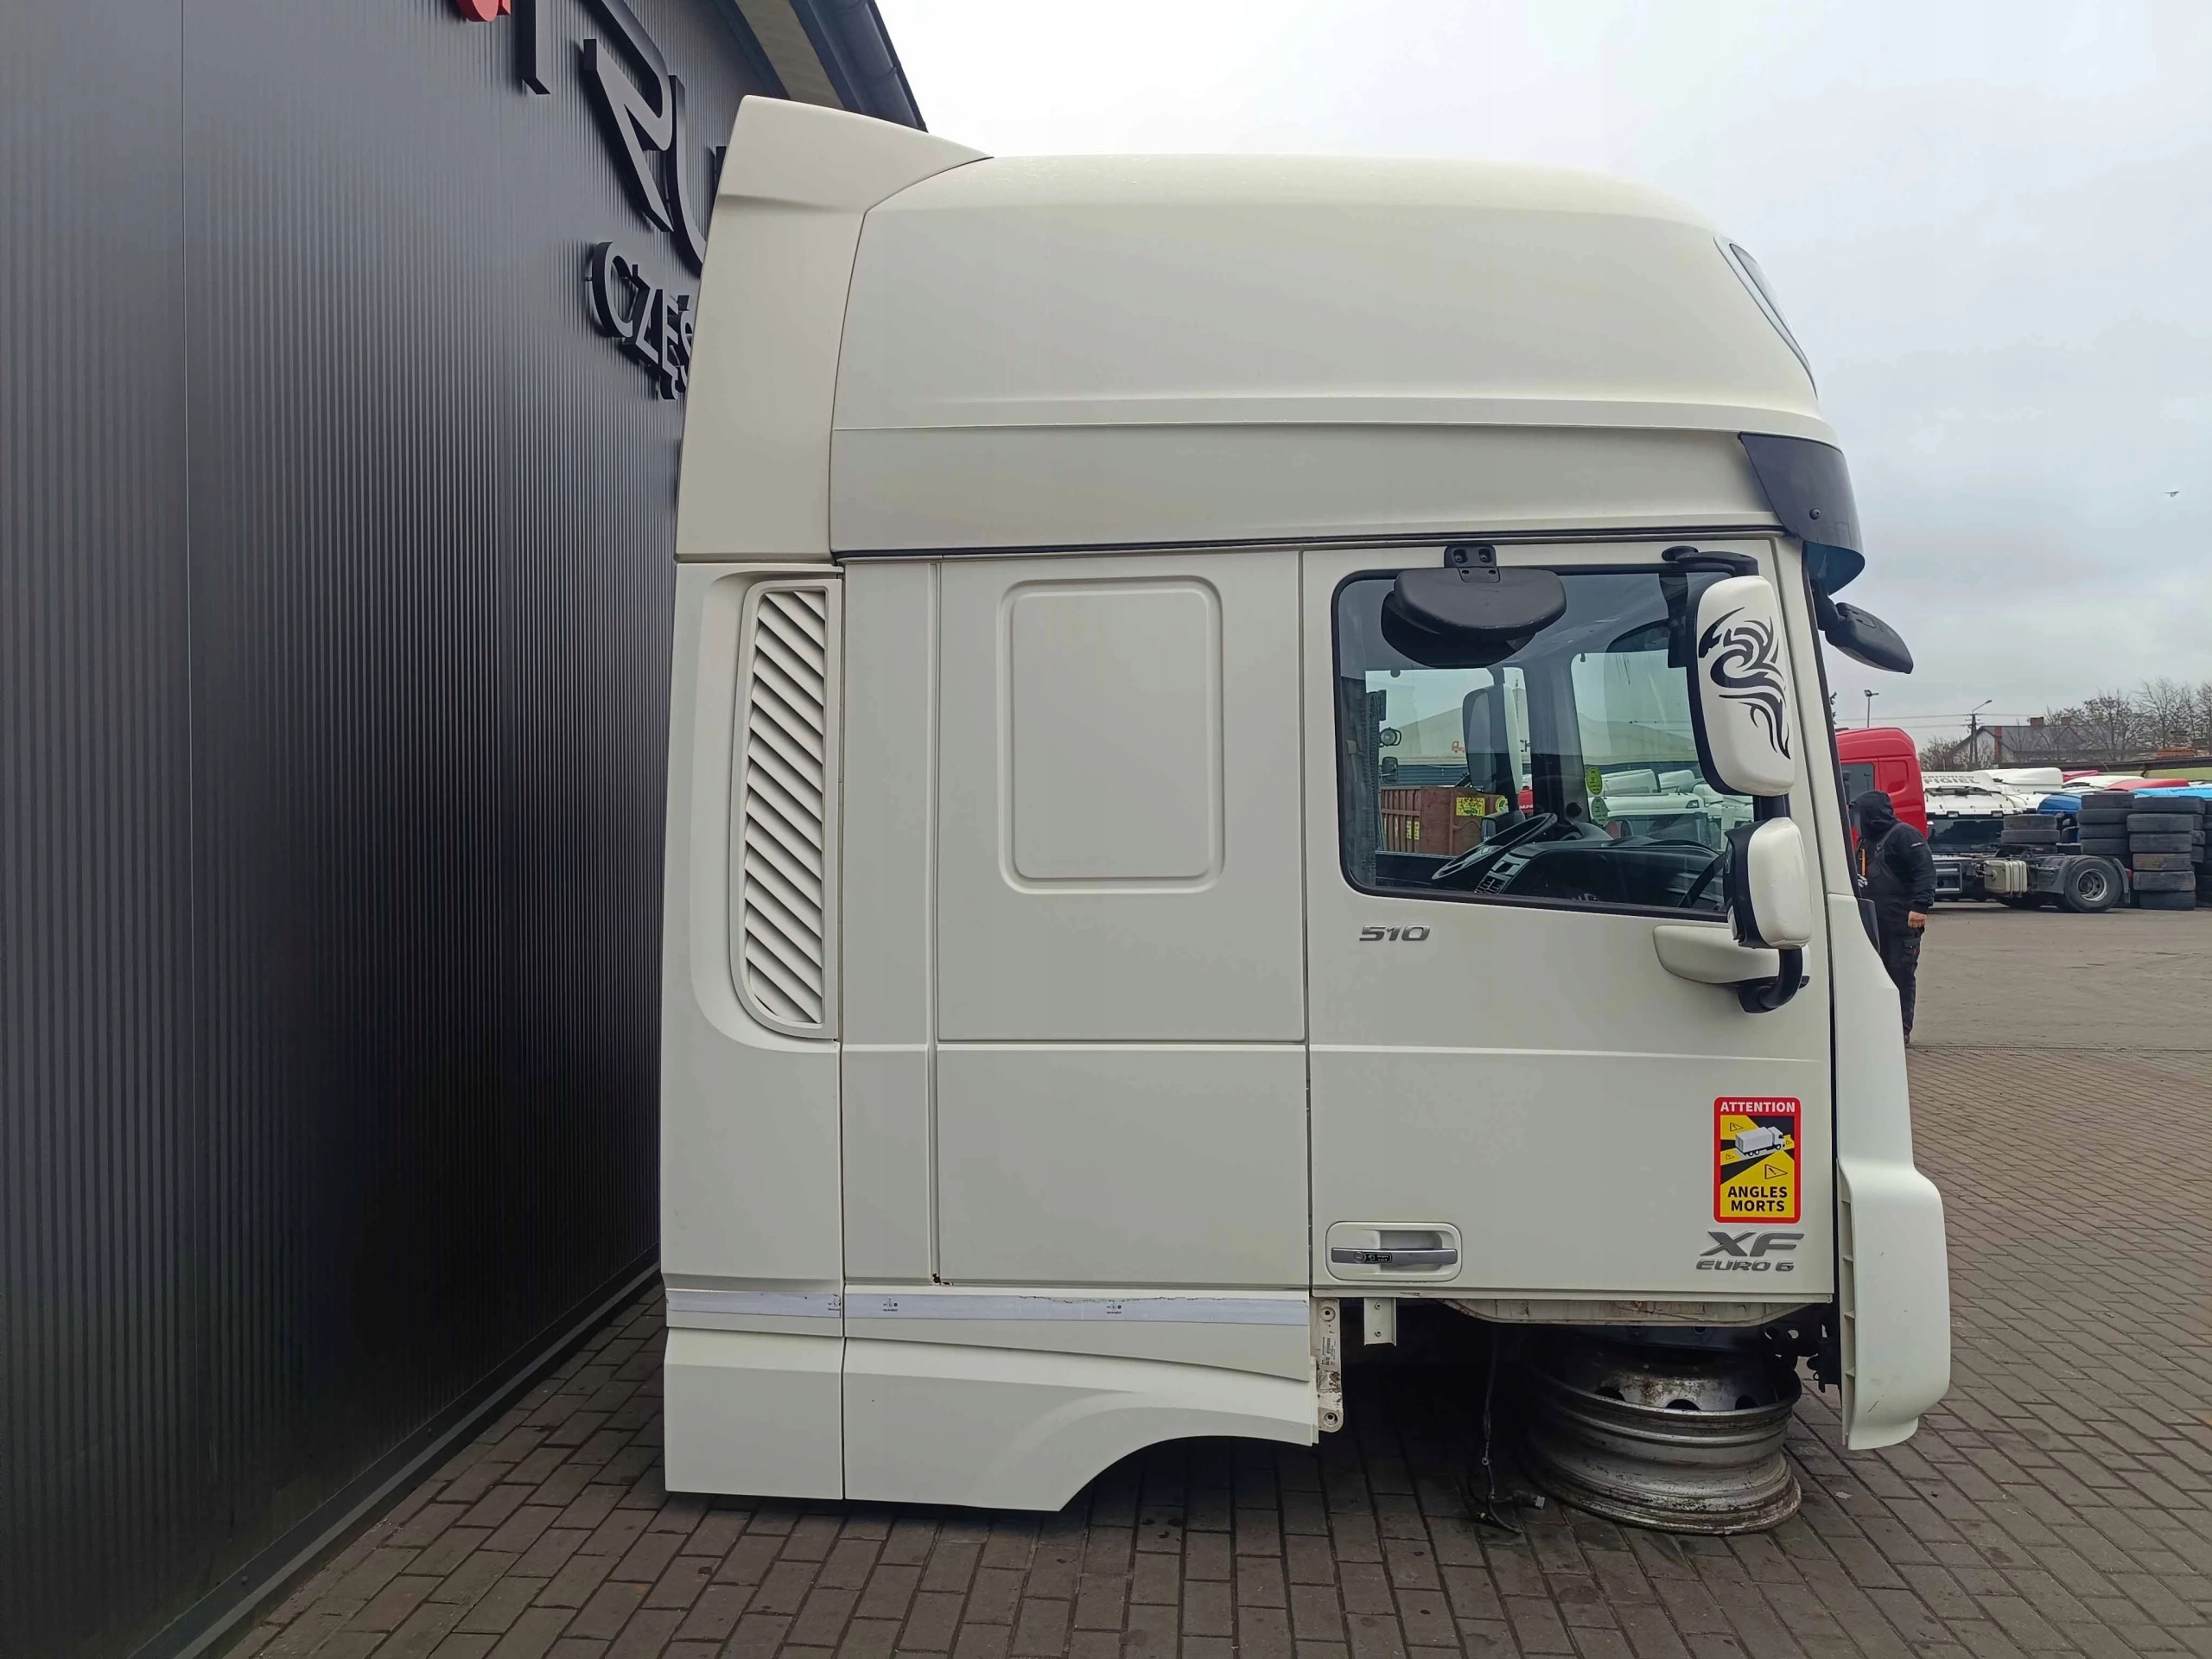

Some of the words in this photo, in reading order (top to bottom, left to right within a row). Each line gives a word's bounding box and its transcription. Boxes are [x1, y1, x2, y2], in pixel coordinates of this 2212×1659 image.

[1359, 925, 1431, 942] 510
[1719, 1101, 1796, 1113] ATTENTION
[1727, 1185, 1788, 1198] ANGLES
[1731, 1199, 1785, 1212] MORTS
[1700, 1230, 1804, 1257] XF
[1696, 1259, 1771, 1272] EURO
[1775, 1259, 1795, 1272] 6
